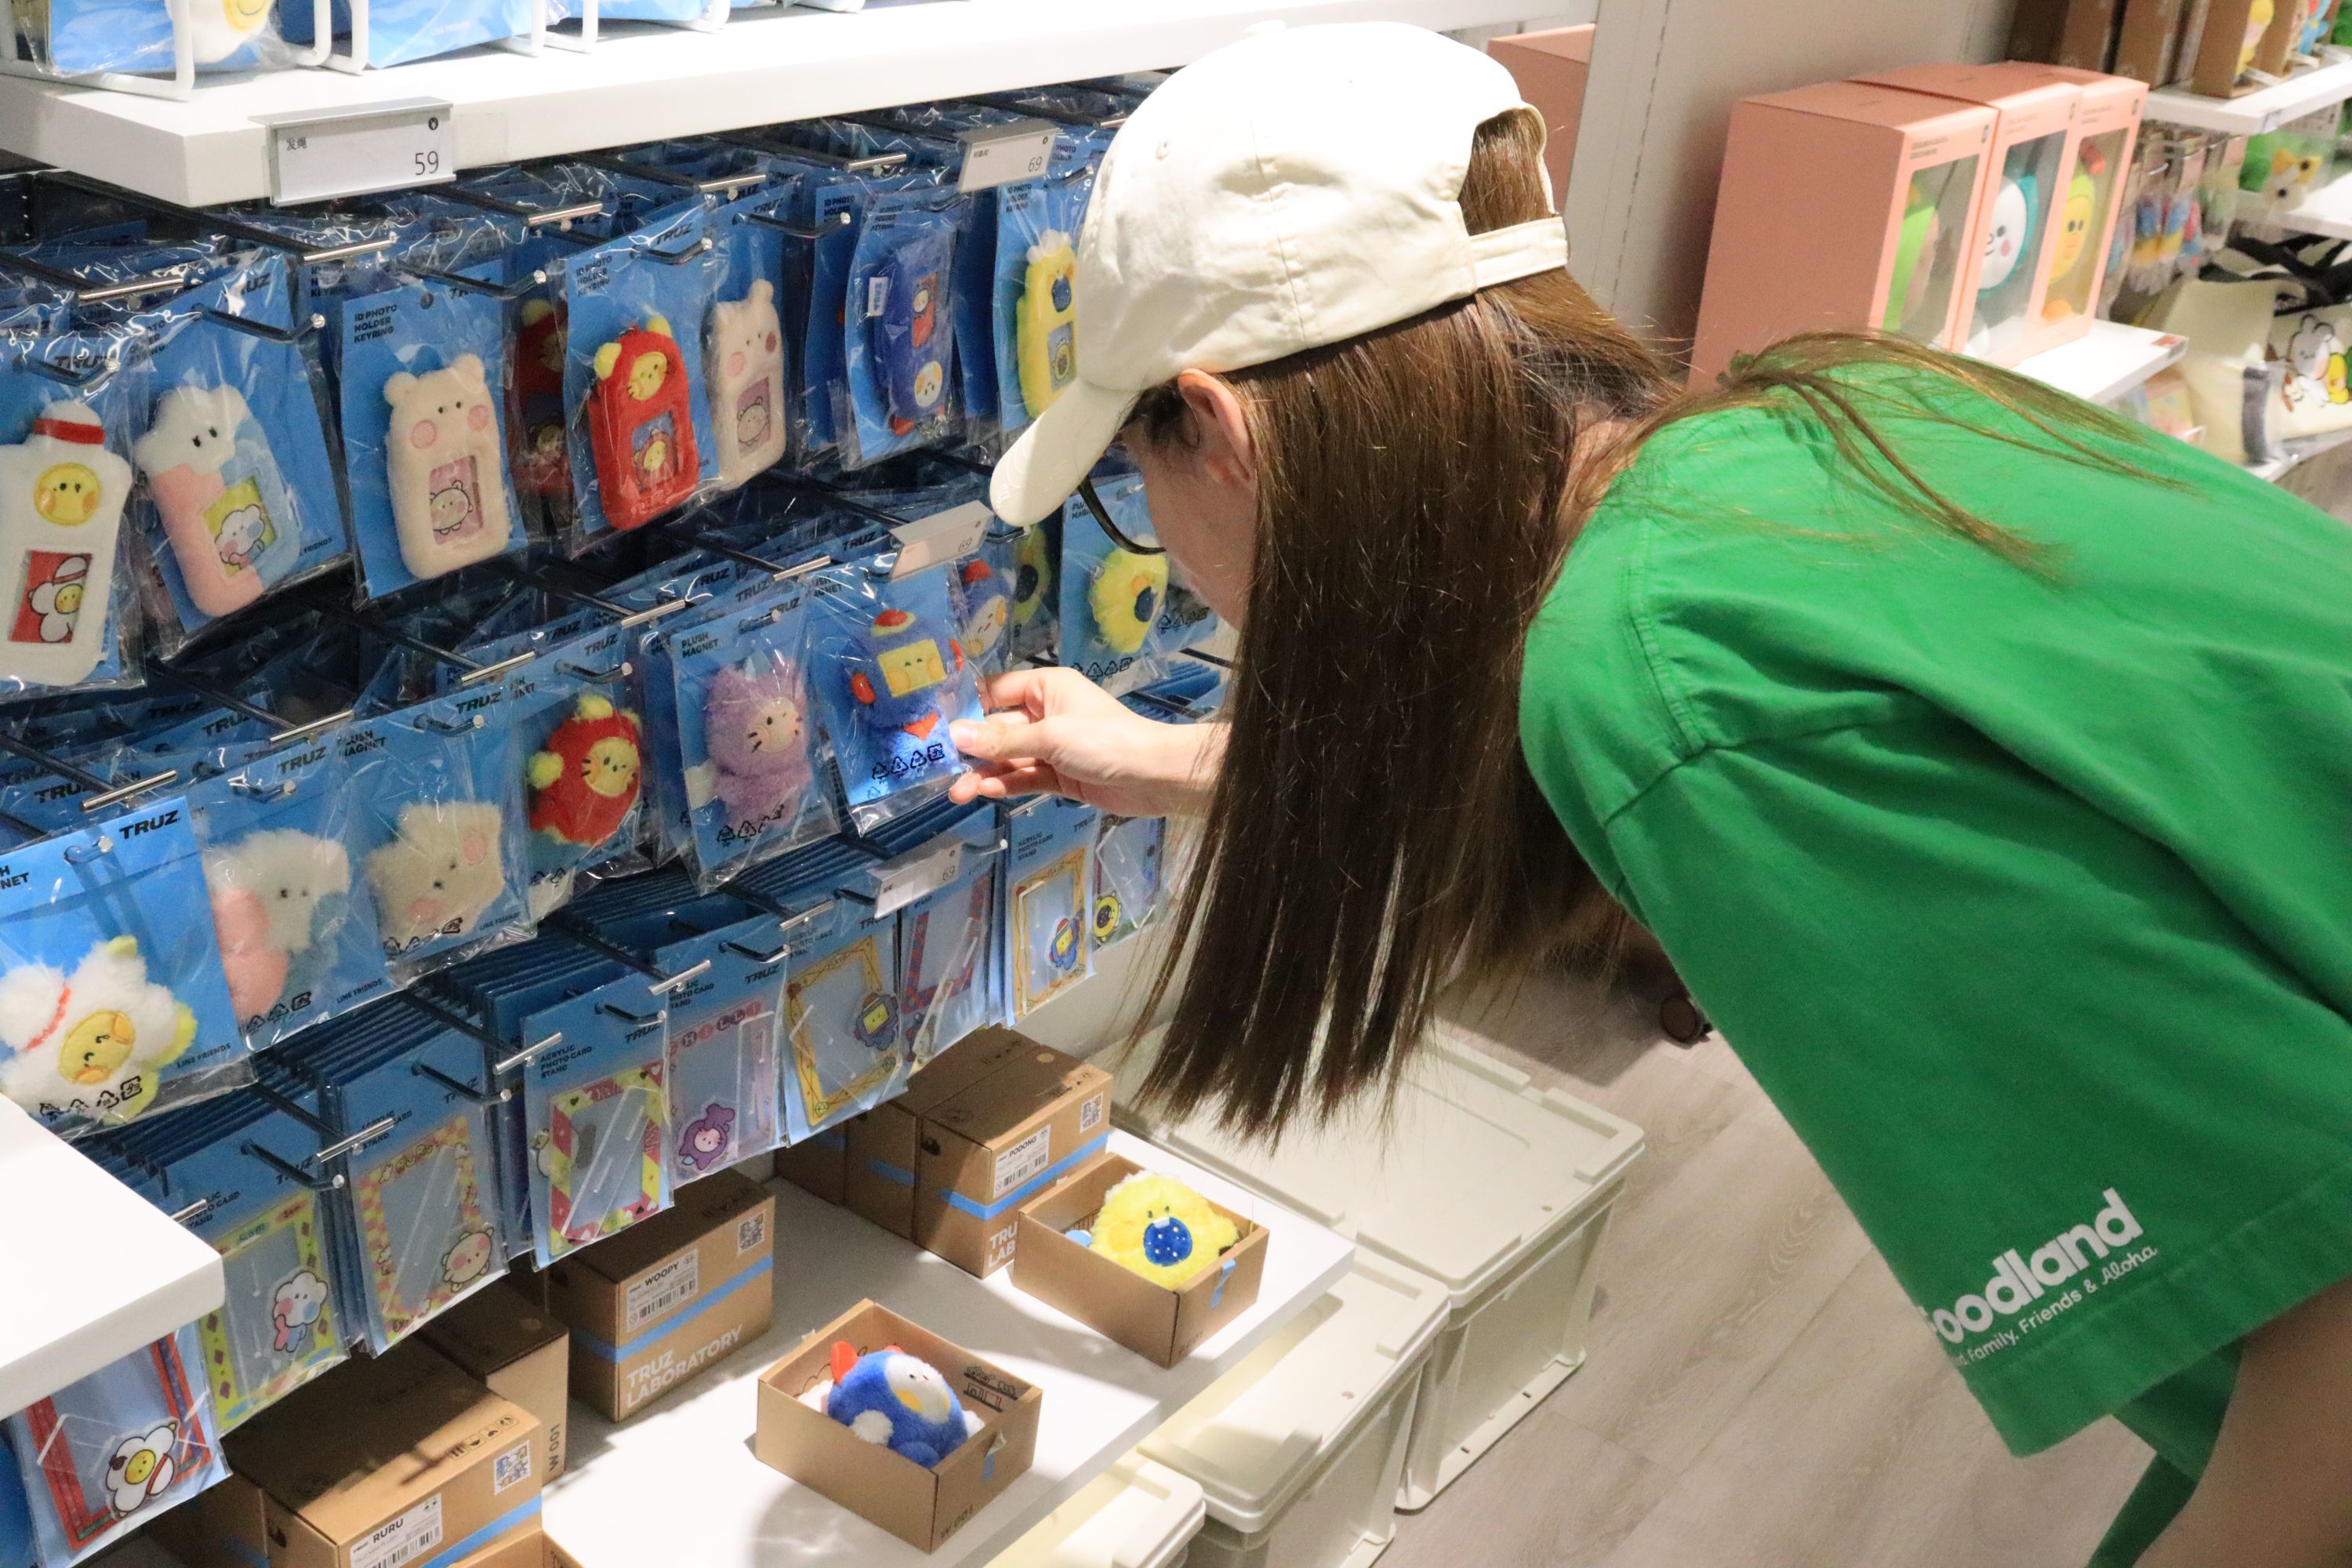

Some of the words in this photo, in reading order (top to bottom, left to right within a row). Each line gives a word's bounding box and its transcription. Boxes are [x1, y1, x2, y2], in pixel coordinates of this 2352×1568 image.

[285, 136, 307, 151] 发绳
[415, 151, 439, 176] 59
[1027, 156, 1043, 172] 69
[824, 199, 832, 208] ID
[832, 194, 855, 206] PHOTO
[824, 205, 851, 217] HOLDER
[655, 223, 693, 245] TRUZ
[354, 312, 365, 323] ID
[365, 304, 397, 321] PHOTO
[354, 316, 392, 334] HOLDER
[354, 325, 395, 344] KEYRING
[1071, 502, 1086, 512] PLU
[956, 538, 973, 554] 69
[735, 580, 769, 603] TRUZ
[583, 633, 619, 656] TRUZ
[681, 631, 710, 648] PLUSH
[681, 638, 719, 659] MAGNET
[455, 691, 502, 715] TRUZ
[201, 710, 251, 738] TRU
[278, 746, 327, 775] TRUZ
[33, 780, 89, 804] TRU
[118, 809, 180, 840] TRUZ
[1018, 831, 1044, 847] ACRYLIC
[1018, 848, 1037, 862] STAND
[0, 871, 30, 891] NET
[941, 865, 956, 881] 69
[745, 964, 780, 985] TRUZ
[336, 993, 352, 1005] LINE
[353, 978, 384, 996] FRIENDS
[693, 982, 715, 996] CARD
[670, 998, 691, 1010] TAND
[624, 1024, 661, 1044] TRUZ
[176, 1057, 196, 1069] LINE
[196, 1042, 232, 1061] FRIENDS
[540, 1044, 576, 1063] ACRYLIC
[540, 1054, 570, 1072] PHOTO
[570, 1045, 593, 1060] CARD
[540, 1064, 568, 1080] STAND
[1008, 1135, 1037, 1158] PODONG
[216, 1191, 241, 1208] CARD
[989, 1221, 1018, 1250] TRU
[644, 1261, 680, 1287] WOOPY
[2018, 1287, 2082, 1334] Friends
[2082, 1278, 2099, 1295] &
[2100, 1244, 2159, 1287] Aloha
[626, 1323, 743, 1409] LABORATORY
[626, 1348, 675, 1388] TRUZ
[372, 1518, 405, 1544] RURU
